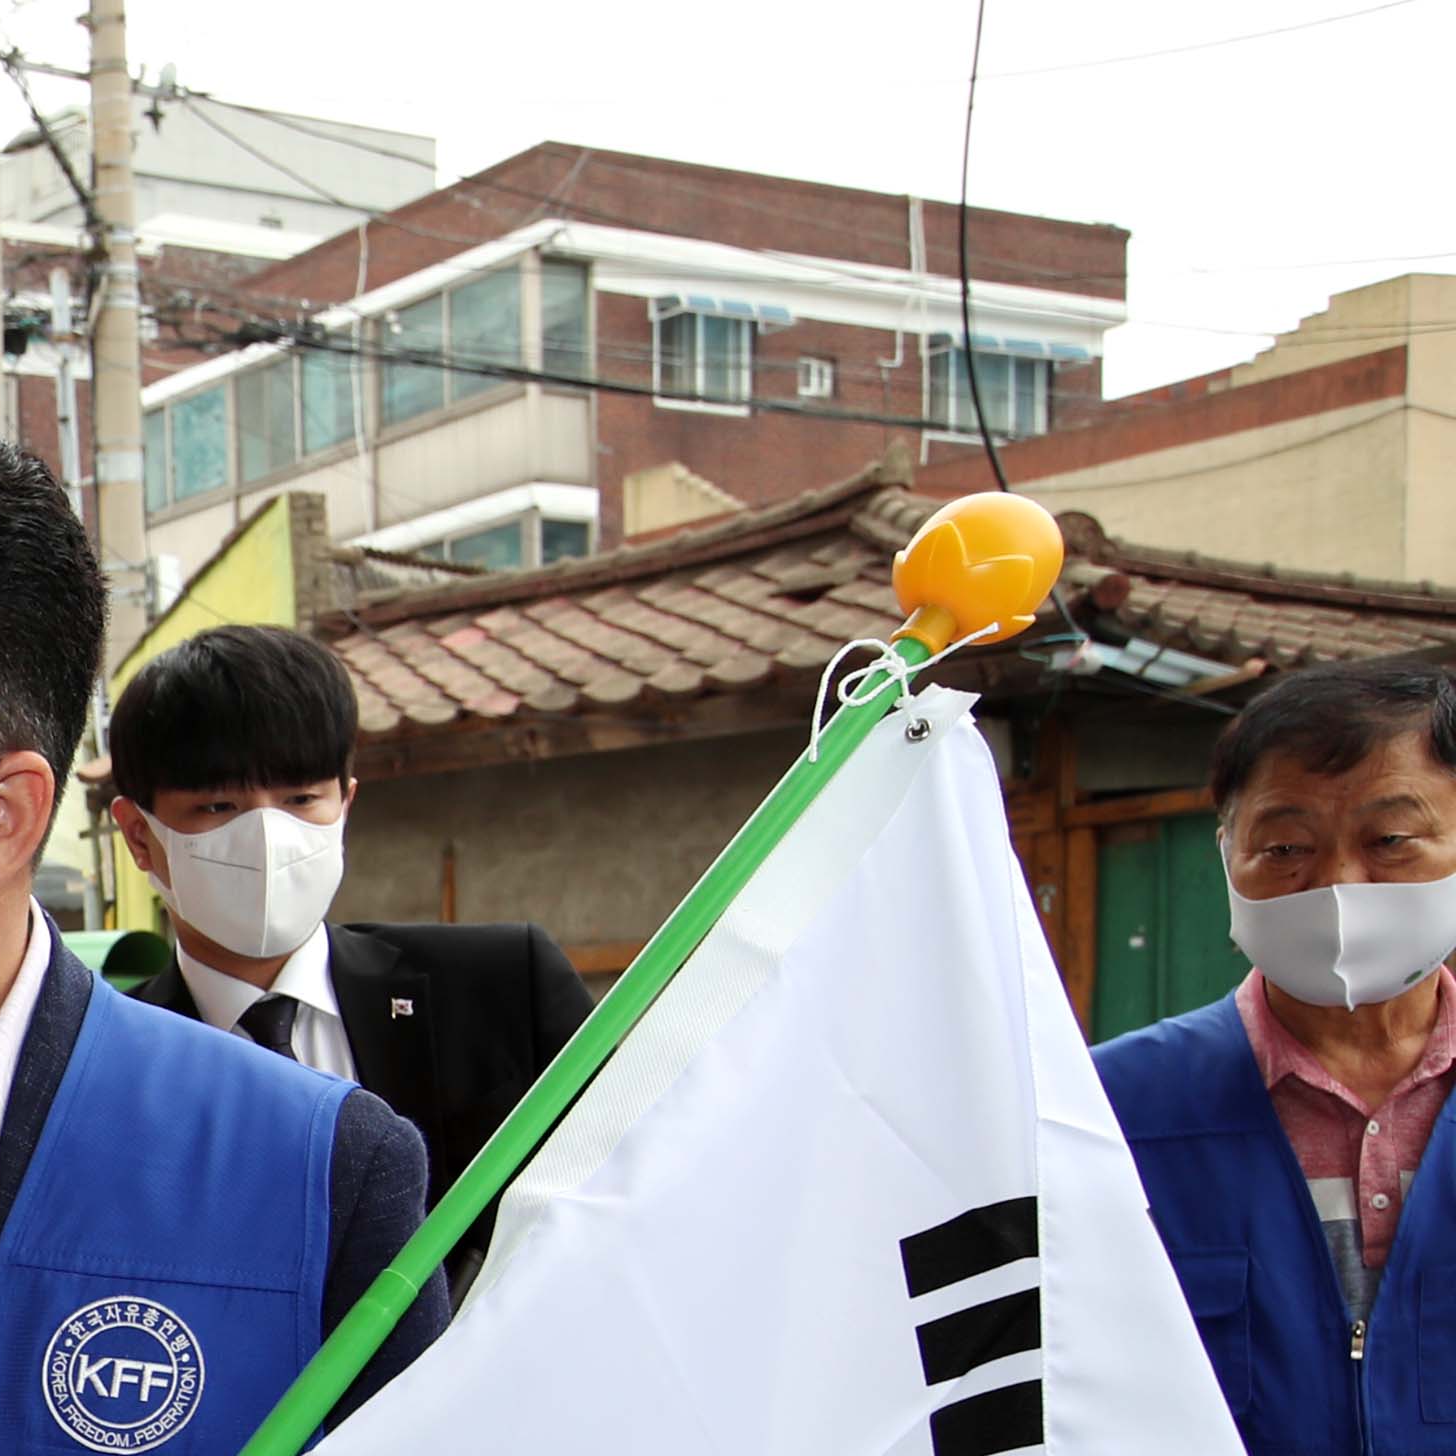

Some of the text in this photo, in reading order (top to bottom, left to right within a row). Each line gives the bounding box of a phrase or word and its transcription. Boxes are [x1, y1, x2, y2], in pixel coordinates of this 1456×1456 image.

[68, 1304, 191, 1353] 한국자유총연맹
[51, 1351, 197, 1447] KOREA FREEDOM FEDERATION
[76, 1354, 173, 1402] KFF
